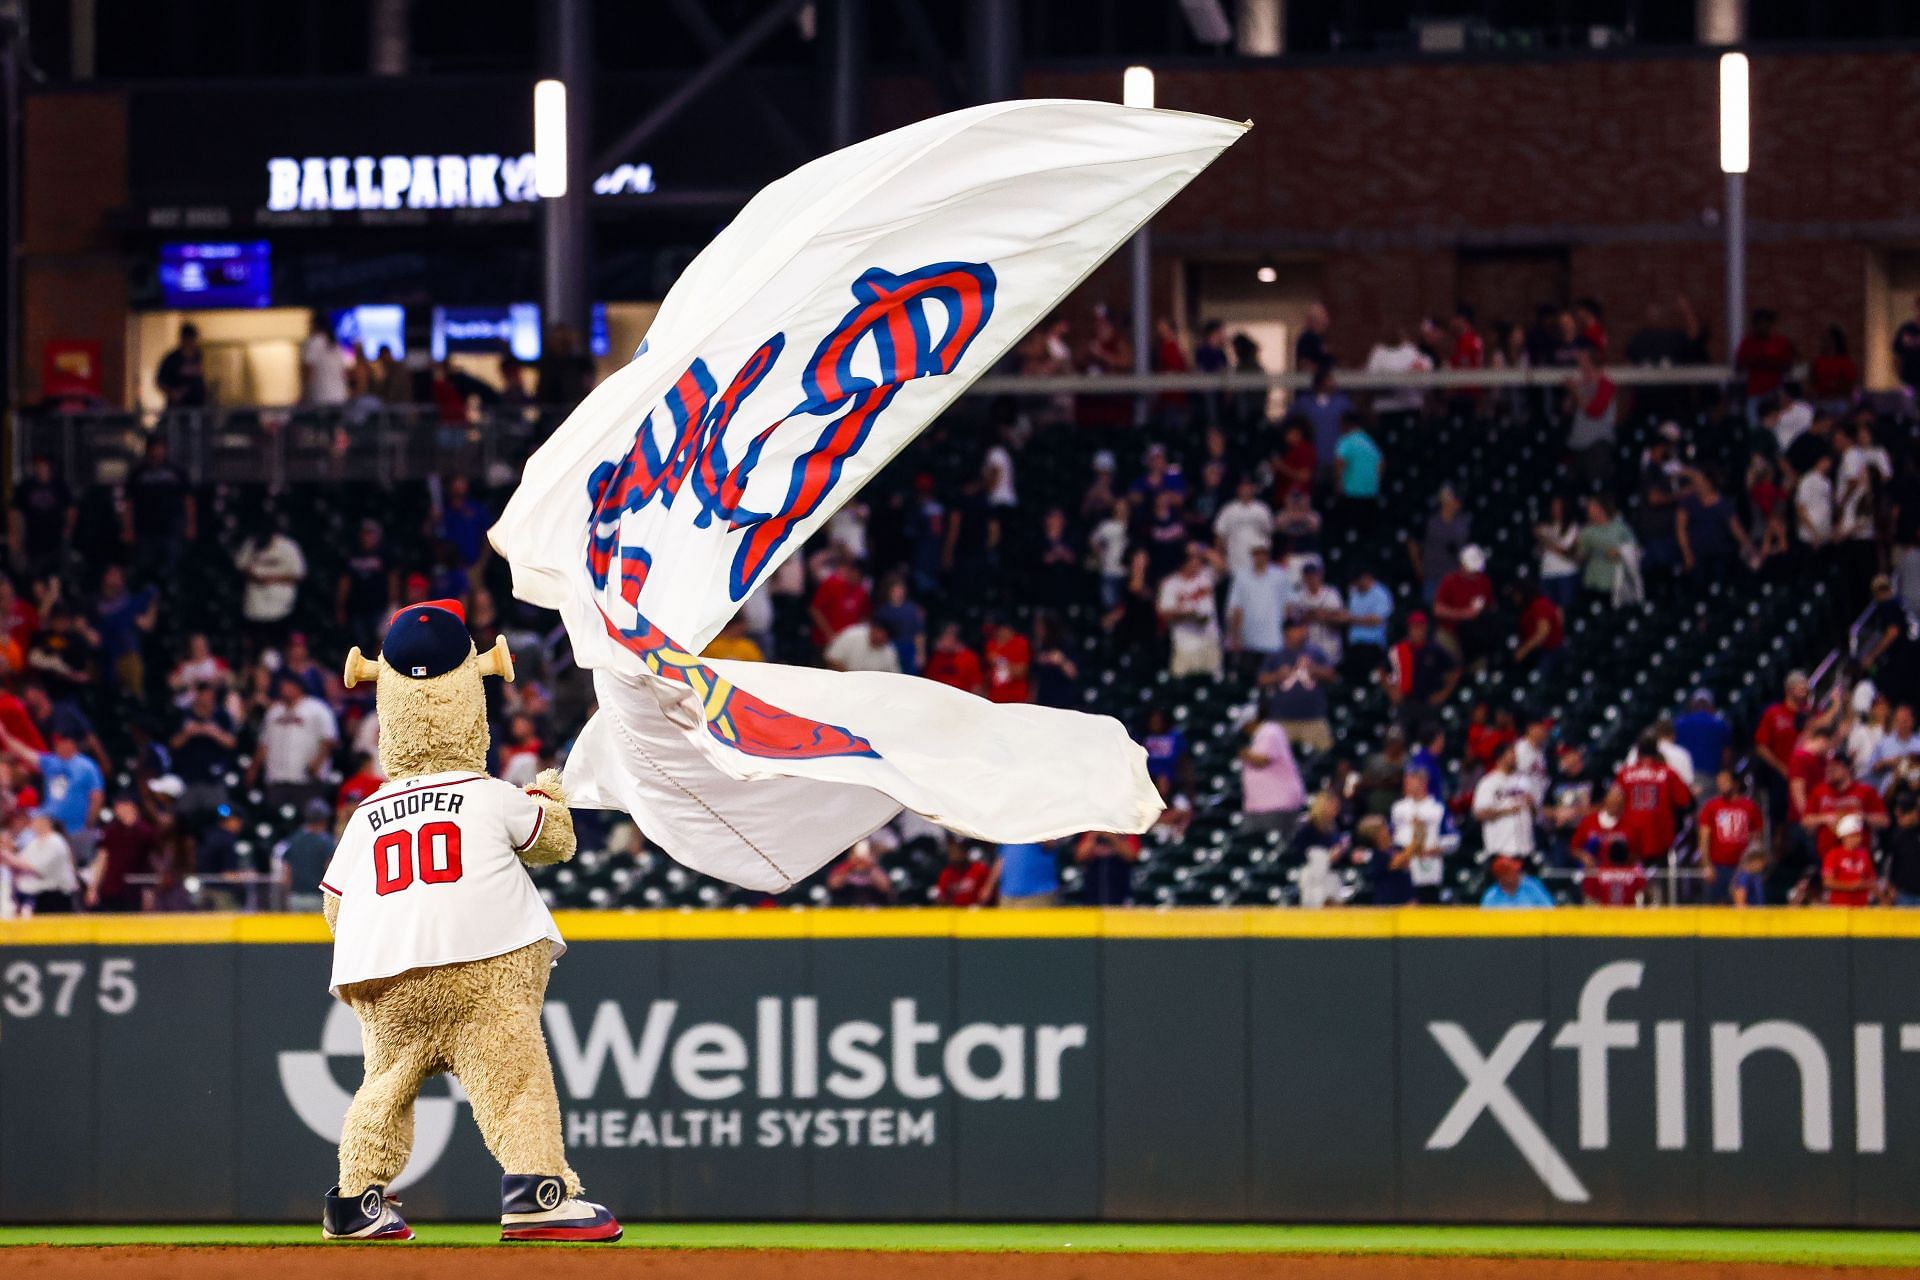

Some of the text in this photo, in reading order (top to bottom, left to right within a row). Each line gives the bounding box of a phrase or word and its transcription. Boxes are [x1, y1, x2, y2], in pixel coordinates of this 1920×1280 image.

[267, 154, 502, 211] BALLPARK
[367, 791, 464, 832] BLOOPER
[373, 820, 463, 897] 00
[3, 957, 137, 1018] 375
[544, 996, 1088, 1100] Wellstar
[566, 1108, 935, 1147] HEALTH SYSTEM
